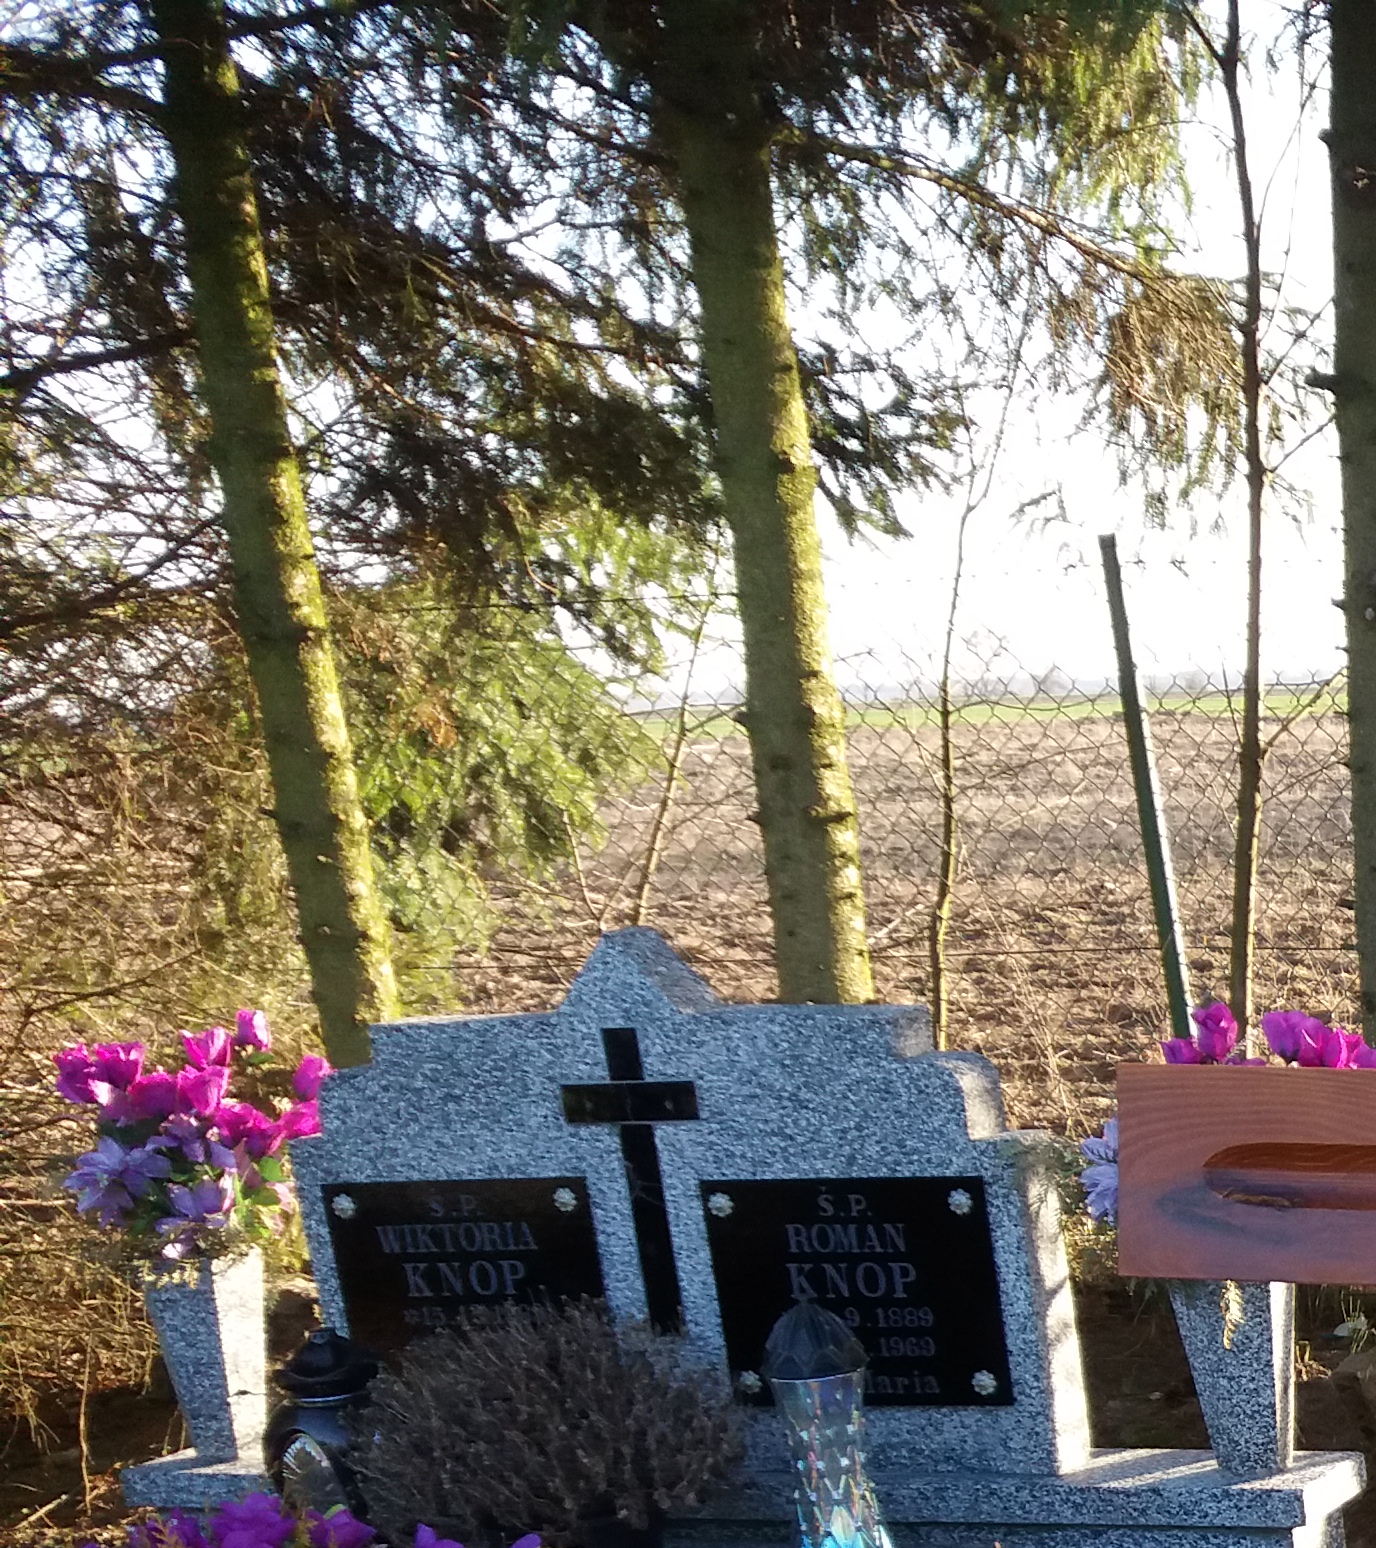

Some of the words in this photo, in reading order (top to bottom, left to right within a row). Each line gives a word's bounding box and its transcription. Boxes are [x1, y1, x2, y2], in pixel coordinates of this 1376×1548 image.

[374, 1221, 539, 1253] WIKTORIA
[784, 1223, 907, 1254] ROMAN
[401, 1259, 526, 1298] KNOP
[785, 1261, 917, 1299] KNOP
